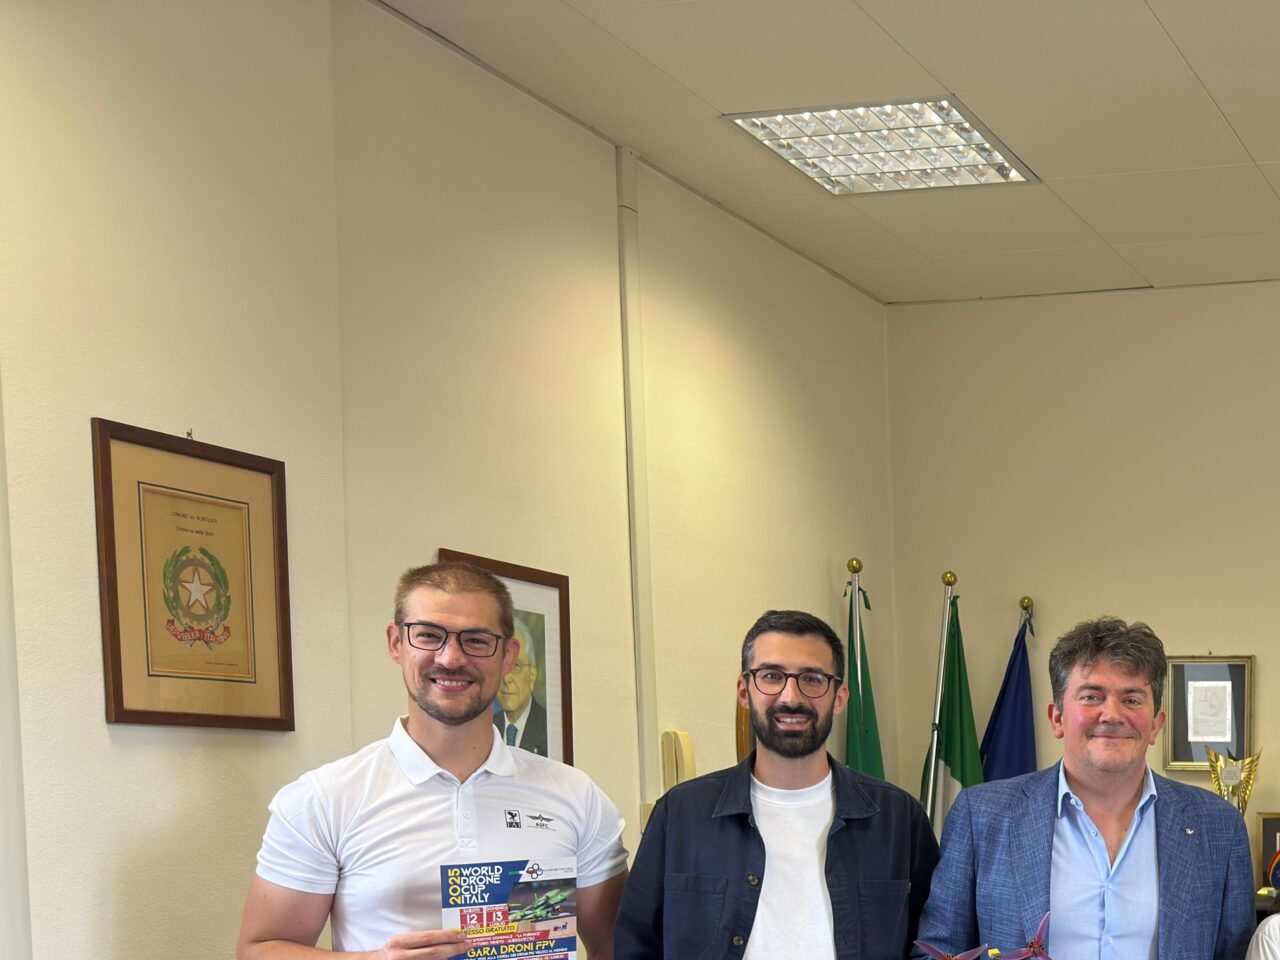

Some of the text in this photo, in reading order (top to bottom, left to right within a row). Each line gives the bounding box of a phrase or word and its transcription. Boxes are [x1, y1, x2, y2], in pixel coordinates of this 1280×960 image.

[461, 866, 503, 876] WORLD
[461, 874, 501, 885] DRONE
[448, 868, 462, 905] 2025
[461, 884, 486, 895] CUP
[461, 893, 490, 904] ITALY
[467, 914, 478, 924] 12
[493, 911, 503, 921] 13
[485, 925, 515, 934] GRATUITO
[467, 946, 497, 958] GARA
[501, 943, 533, 955] DRONI
[536, 940, 555, 950] FPV
